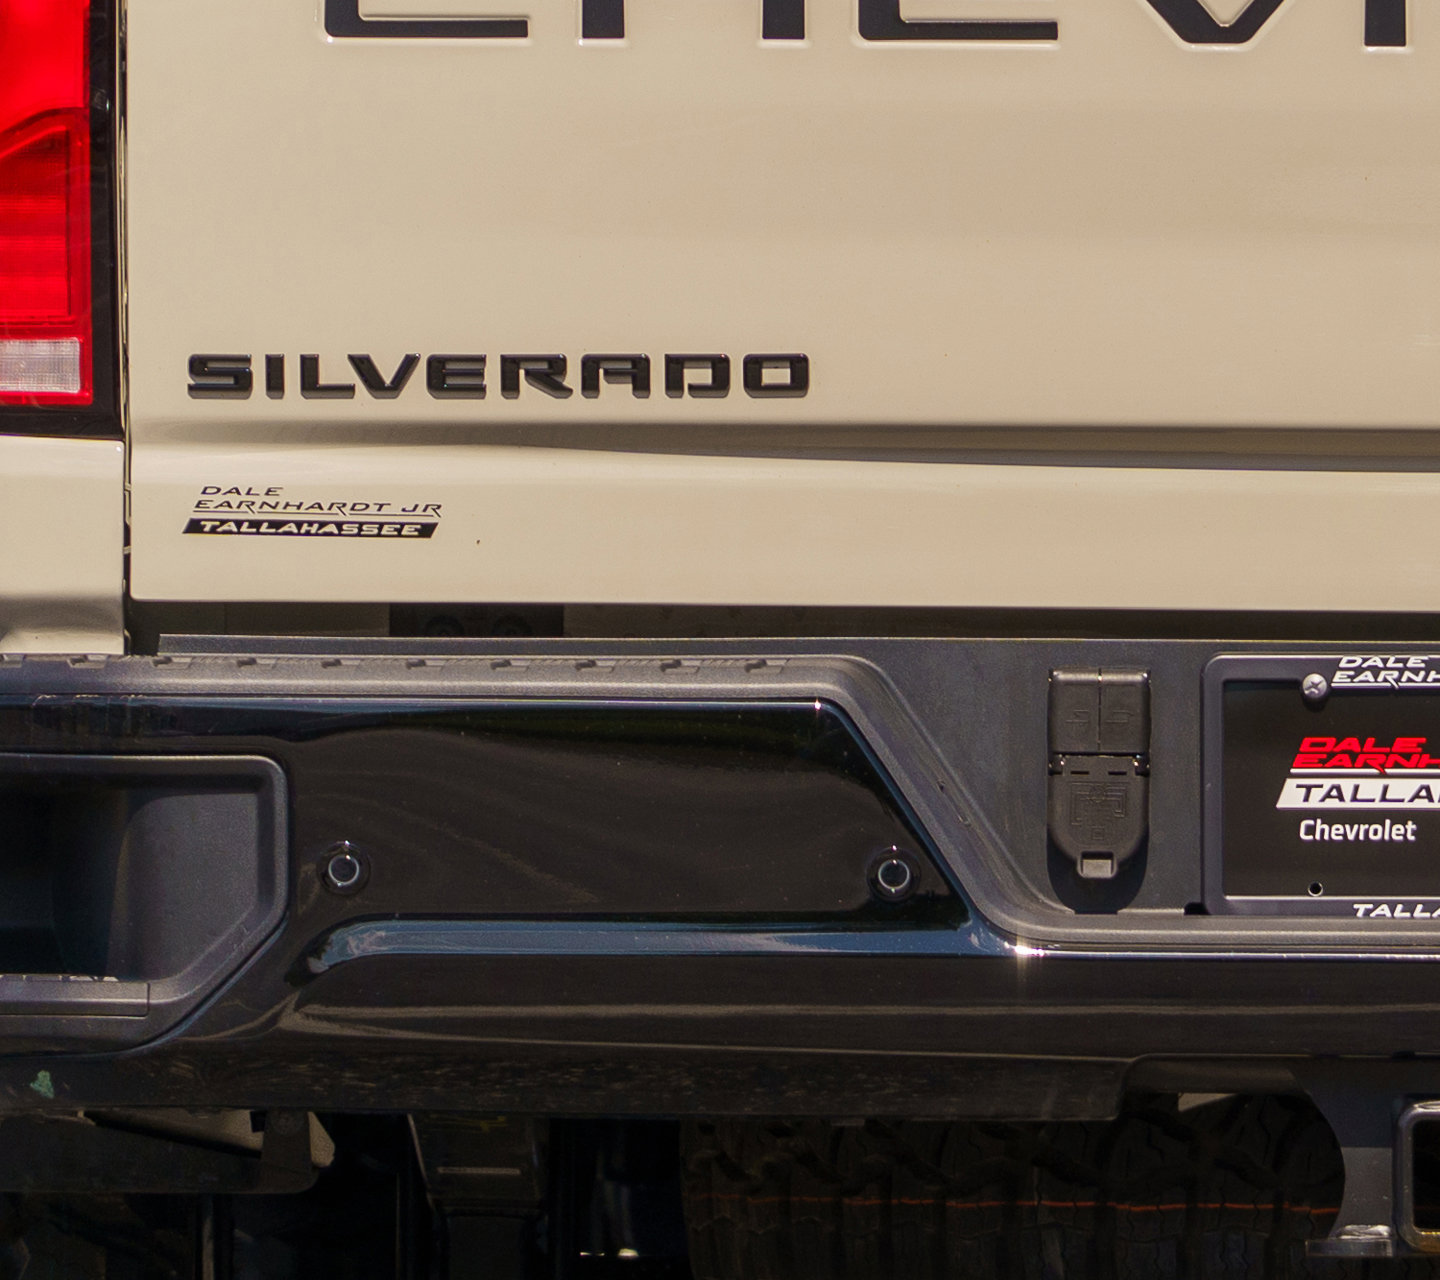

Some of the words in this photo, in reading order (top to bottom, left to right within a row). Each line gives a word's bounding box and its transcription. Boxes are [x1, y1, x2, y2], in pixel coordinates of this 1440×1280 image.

[187, 353, 810, 400] SILVERADO
[200, 485, 284, 497] DALE
[193, 499, 392, 516] EARNHARDT
[401, 502, 443, 518] JR
[199, 520, 423, 536] TALLAHASSEE
[1338, 655, 1430, 669] DALE
[1298, 736, 1427, 753] DALE
[1298, 819, 1417, 842] Chevrolet
